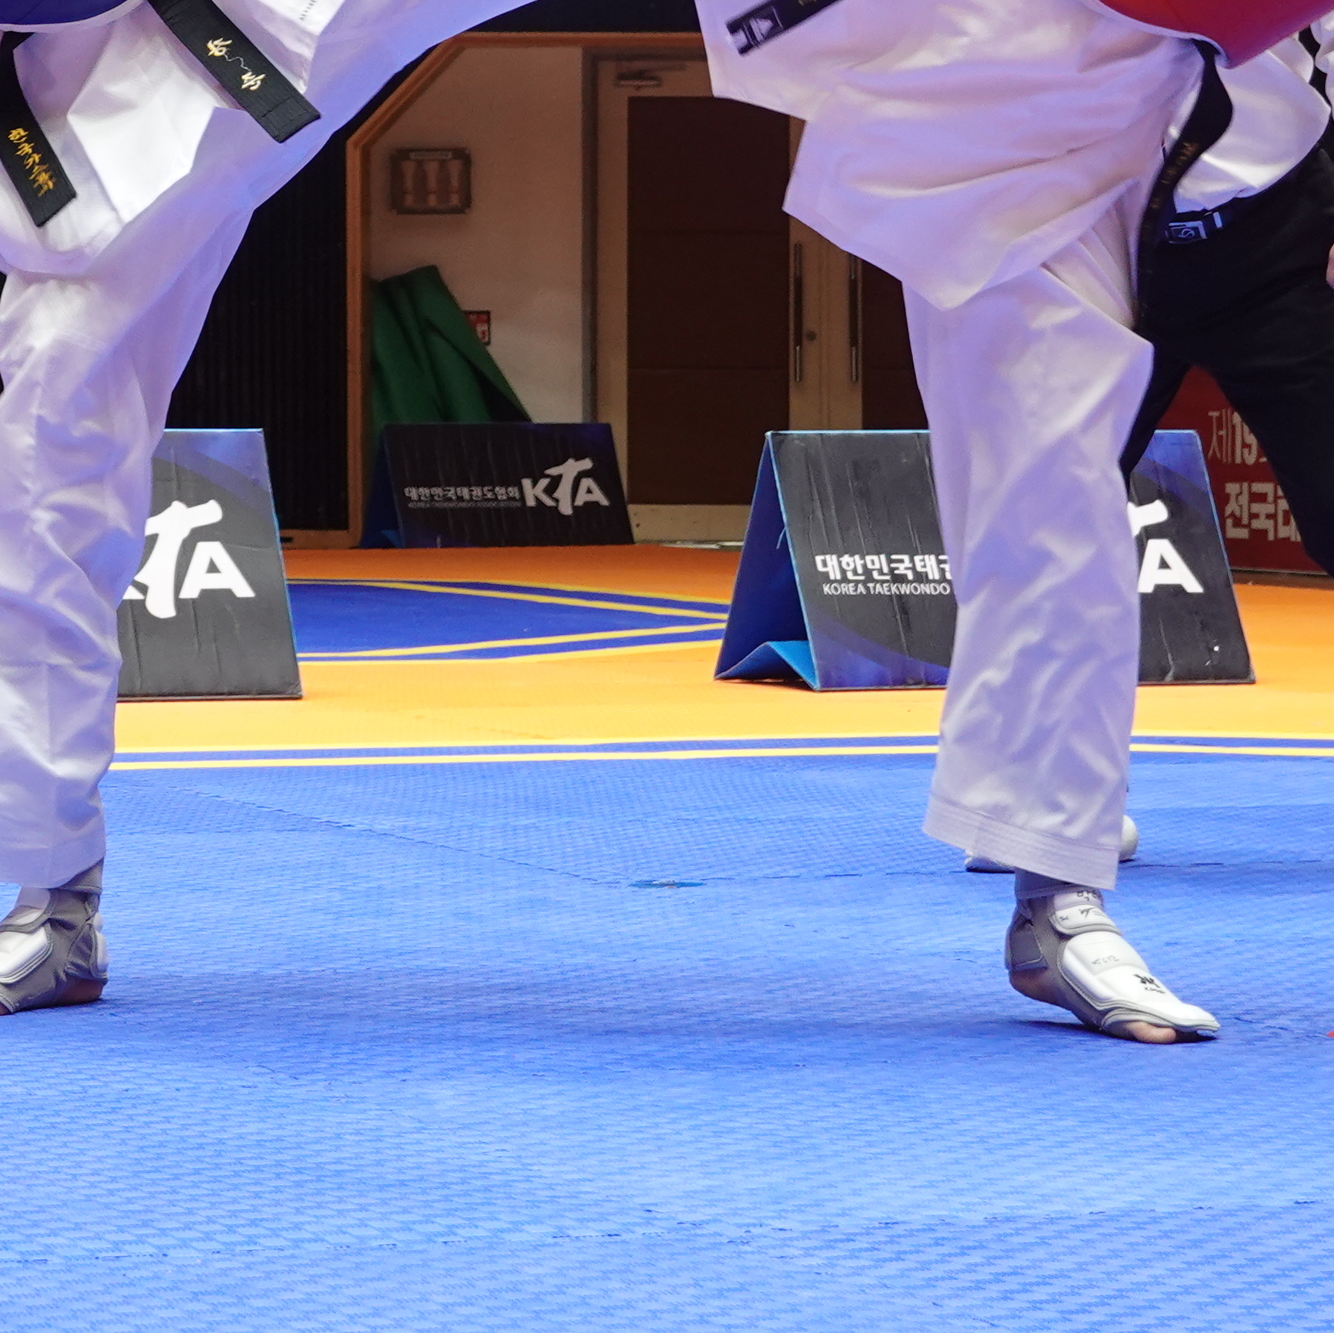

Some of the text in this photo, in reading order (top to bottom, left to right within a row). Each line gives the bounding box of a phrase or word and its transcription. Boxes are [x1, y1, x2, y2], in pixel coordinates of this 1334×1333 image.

[403, 486, 521, 501] 대한민국태권도협회
[521, 457, 611, 516] KTA
[122, 499, 256, 619] TA
[823, 582, 952, 596] KOREA TAEKWONDO
